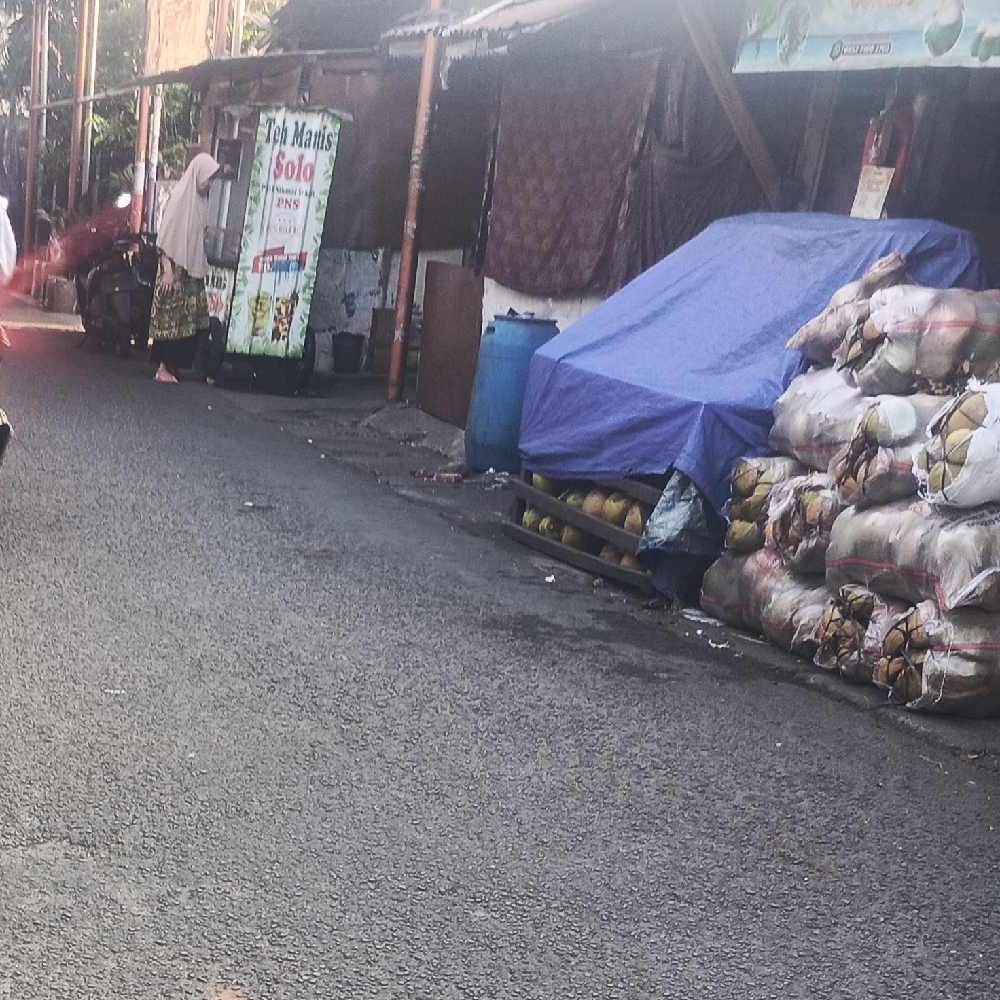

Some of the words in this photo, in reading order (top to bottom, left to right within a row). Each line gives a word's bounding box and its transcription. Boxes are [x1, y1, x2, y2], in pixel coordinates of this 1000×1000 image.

[265, 117, 288, 146] Teh
[291, 120, 334, 152] Manis
[273, 149, 315, 183] Solo
[276, 197, 300, 210] PNS
